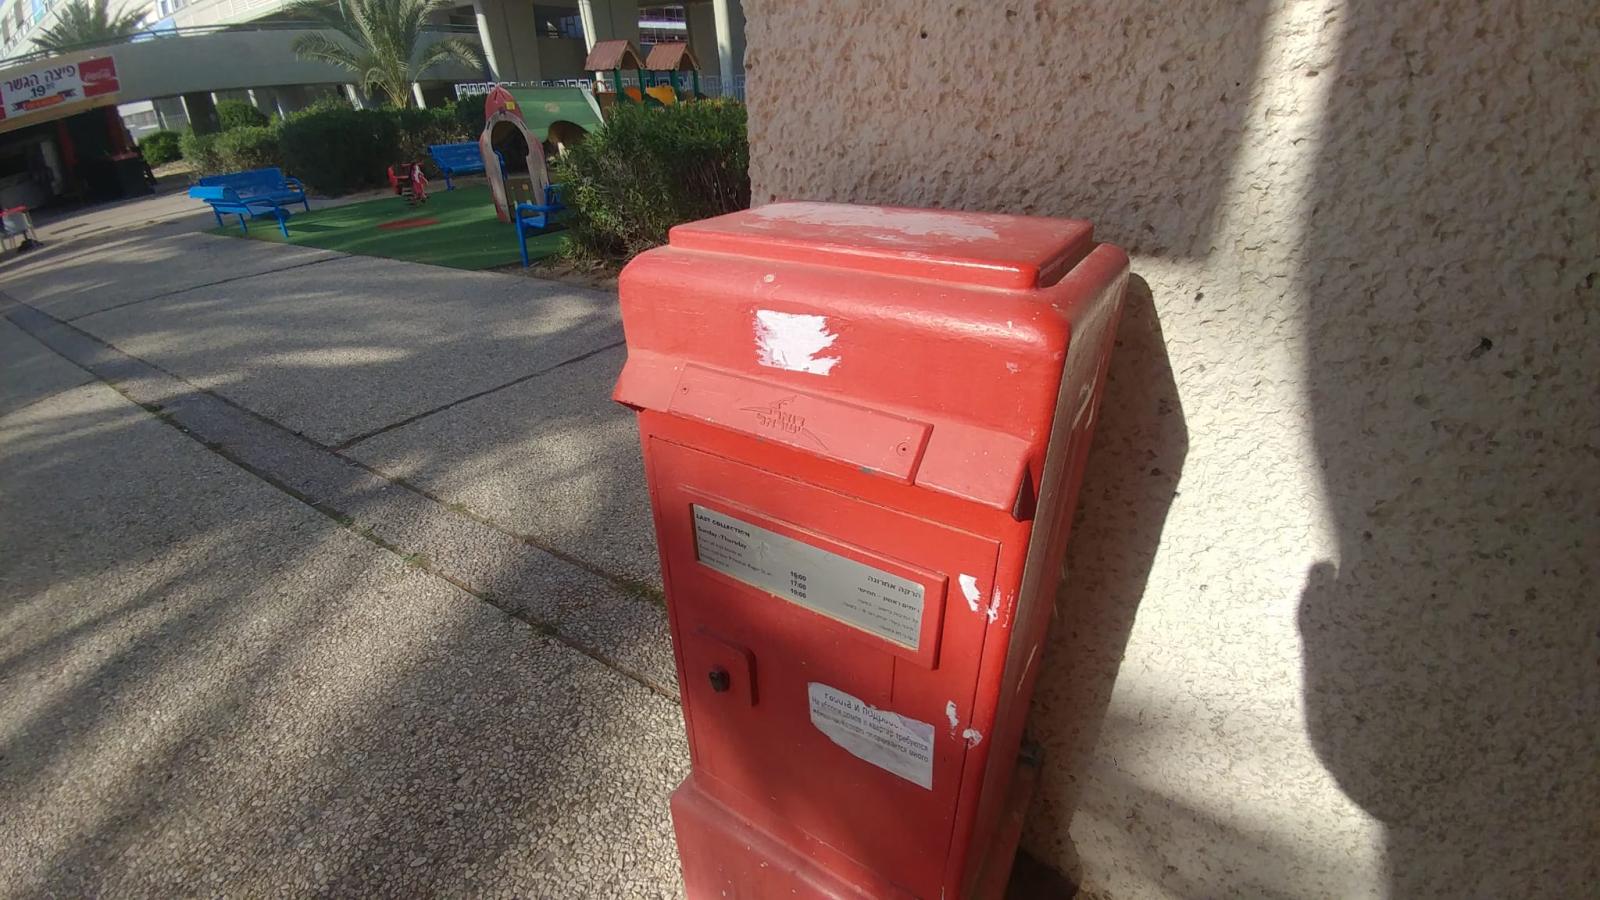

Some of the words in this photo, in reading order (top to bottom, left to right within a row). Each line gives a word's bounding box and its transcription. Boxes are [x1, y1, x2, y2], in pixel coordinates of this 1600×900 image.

[43, 65, 76, 82] פיצה
[5, 74, 40, 93] הגשר
[31, 85, 46, 98] 19
[696, 513, 711, 522] LAST
[712, 520, 750, 538] COLLECTION
[697, 526, 717, 539] Sunday
[720, 534, 747, 550] Thursday
